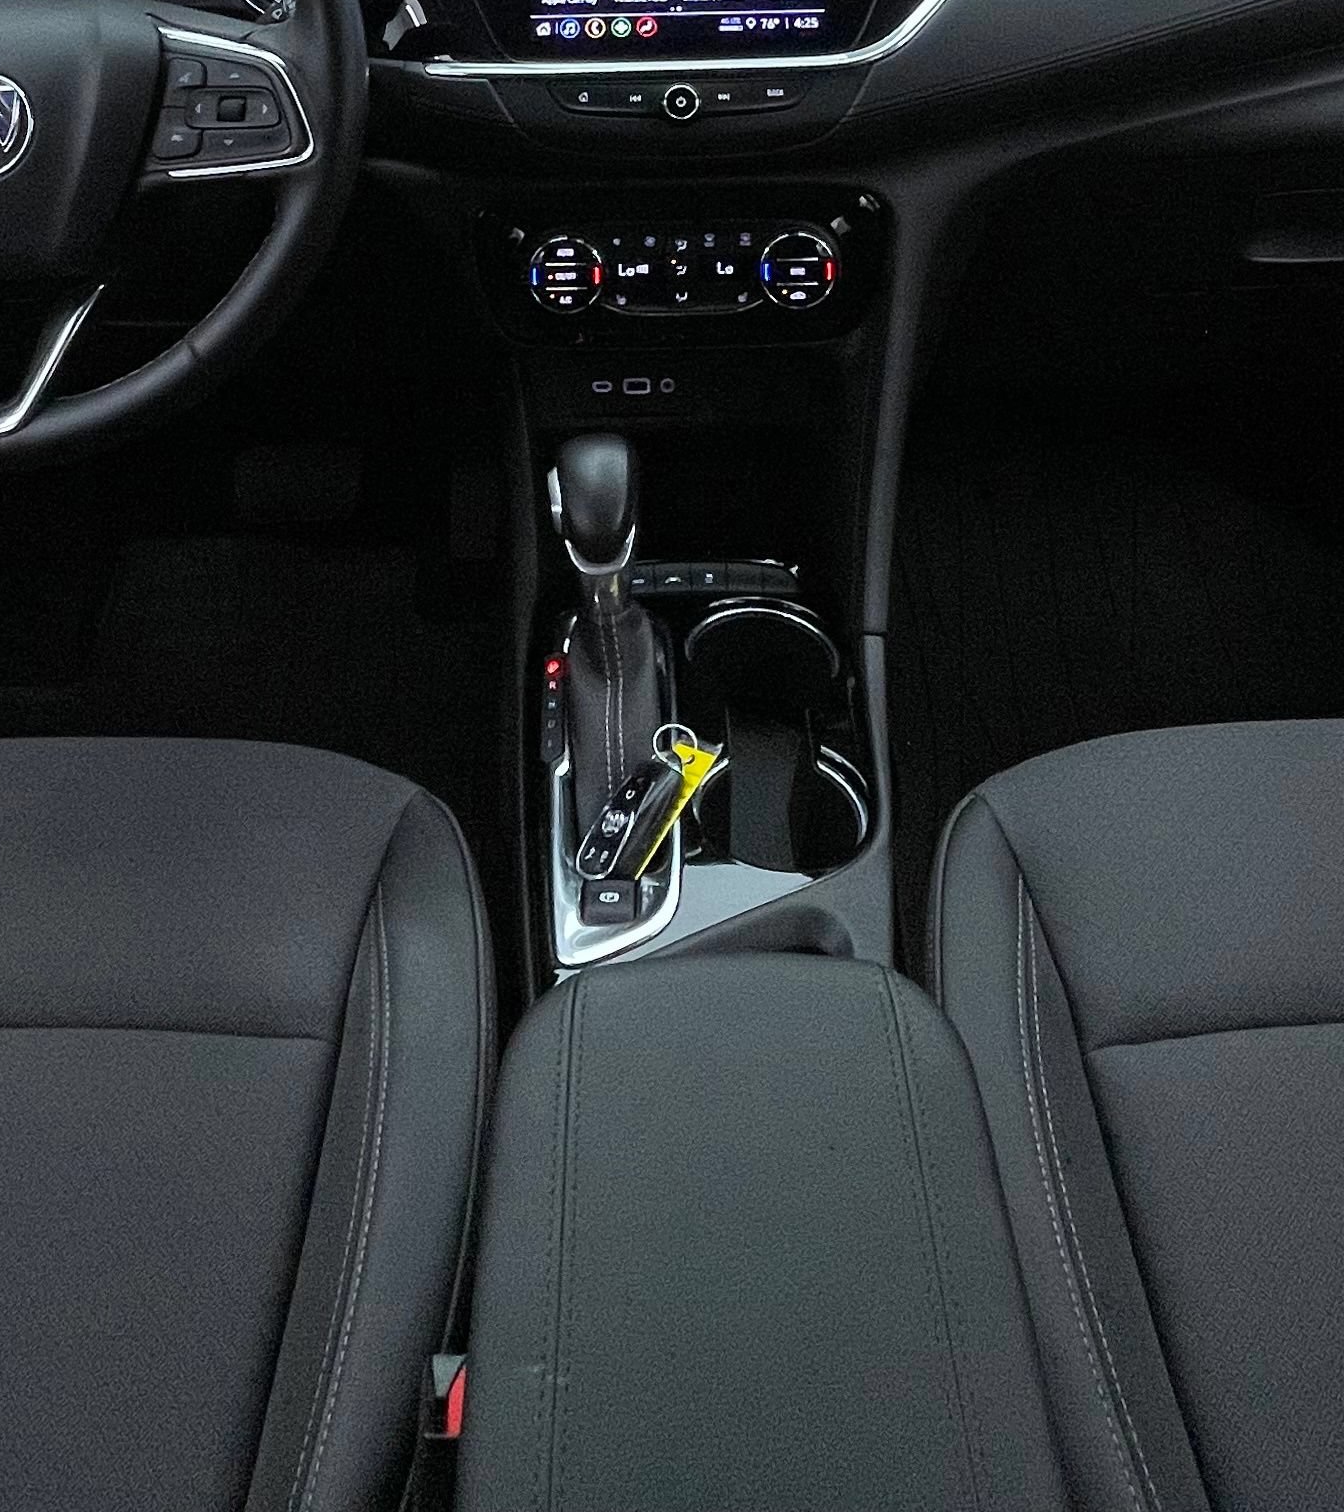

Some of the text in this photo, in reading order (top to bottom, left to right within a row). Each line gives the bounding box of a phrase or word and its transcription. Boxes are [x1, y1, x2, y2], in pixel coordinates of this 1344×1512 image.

[793, 16, 820, 29] 4:25
[618, 263, 636, 277] Lo
[716, 261, 734, 275] Lo
